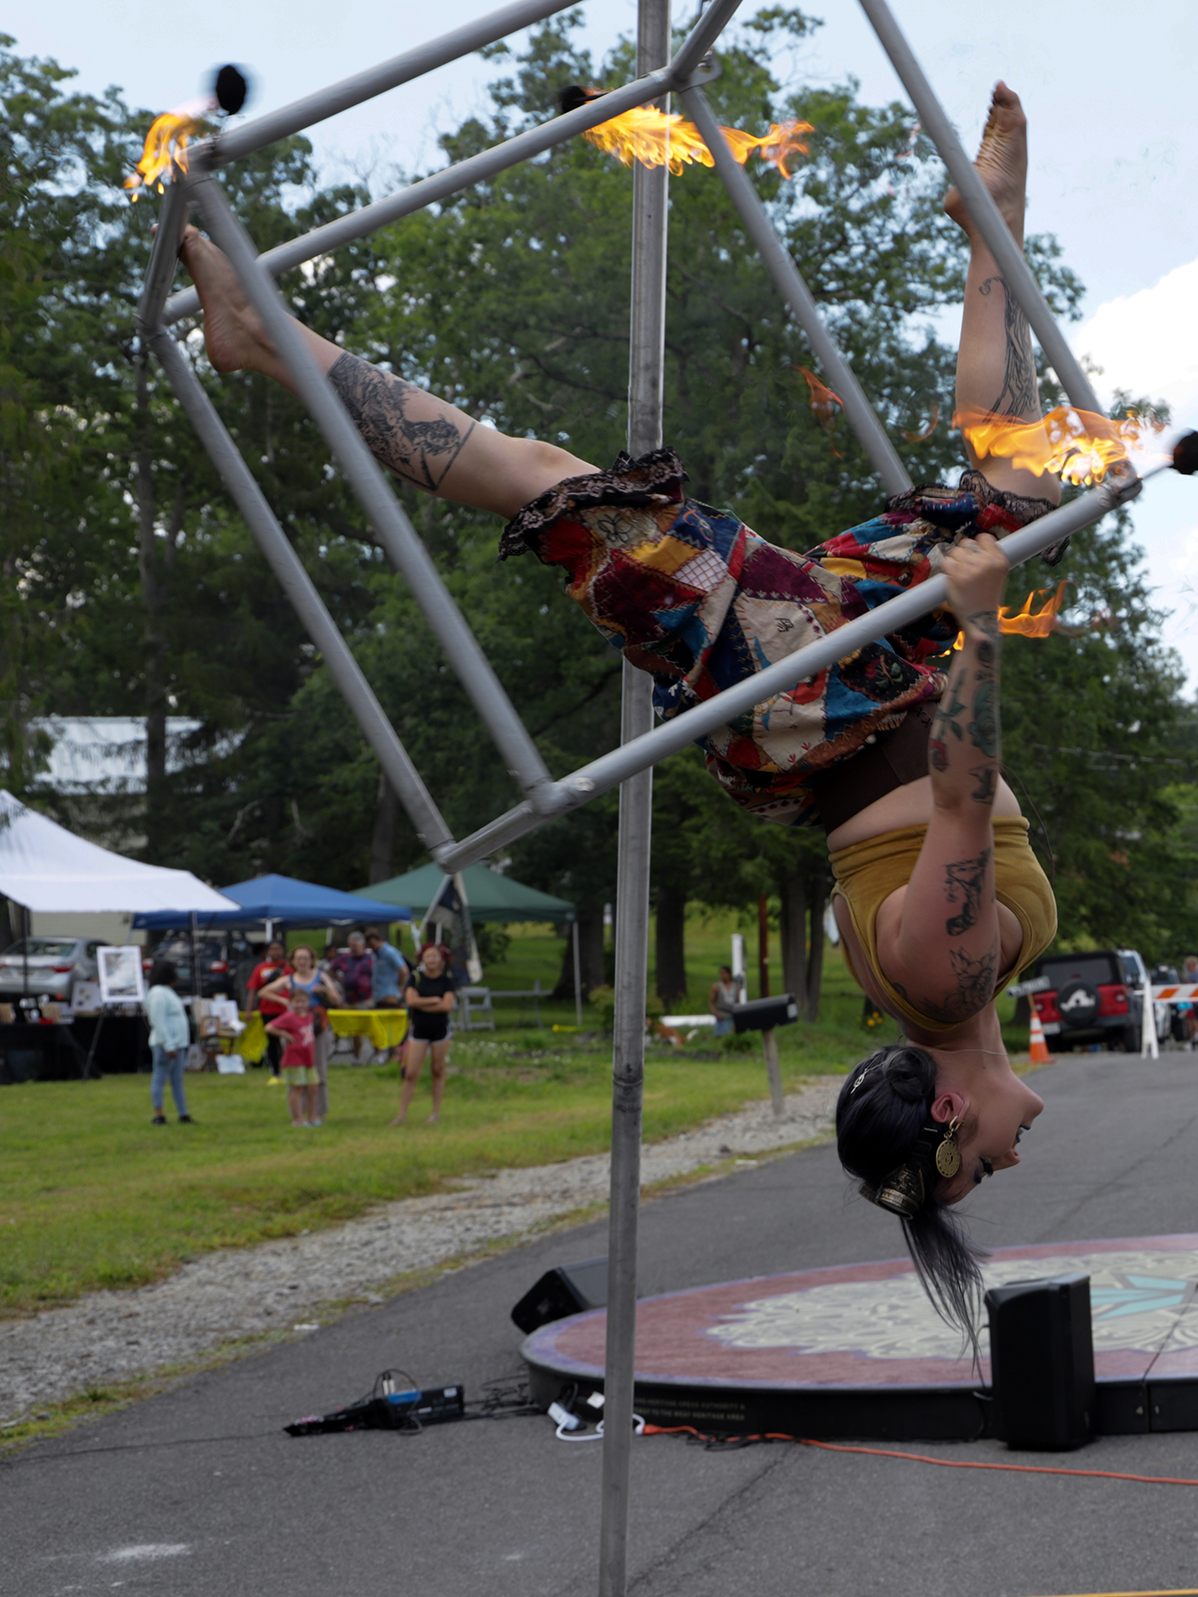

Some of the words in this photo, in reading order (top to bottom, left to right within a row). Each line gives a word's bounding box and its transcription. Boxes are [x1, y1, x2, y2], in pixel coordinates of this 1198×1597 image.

[646, 1397, 677, 1408] HERITAGE
[660, 1408, 673, 1417] THE
[673, 1410, 691, 1419] WEST
[692, 1411, 725, 1420] HERITAGE
[726, 1412, 746, 1421] AREA
[1135, 1405, 1144, 1415] 4
[1154, 1405, 1160, 1415] 1
